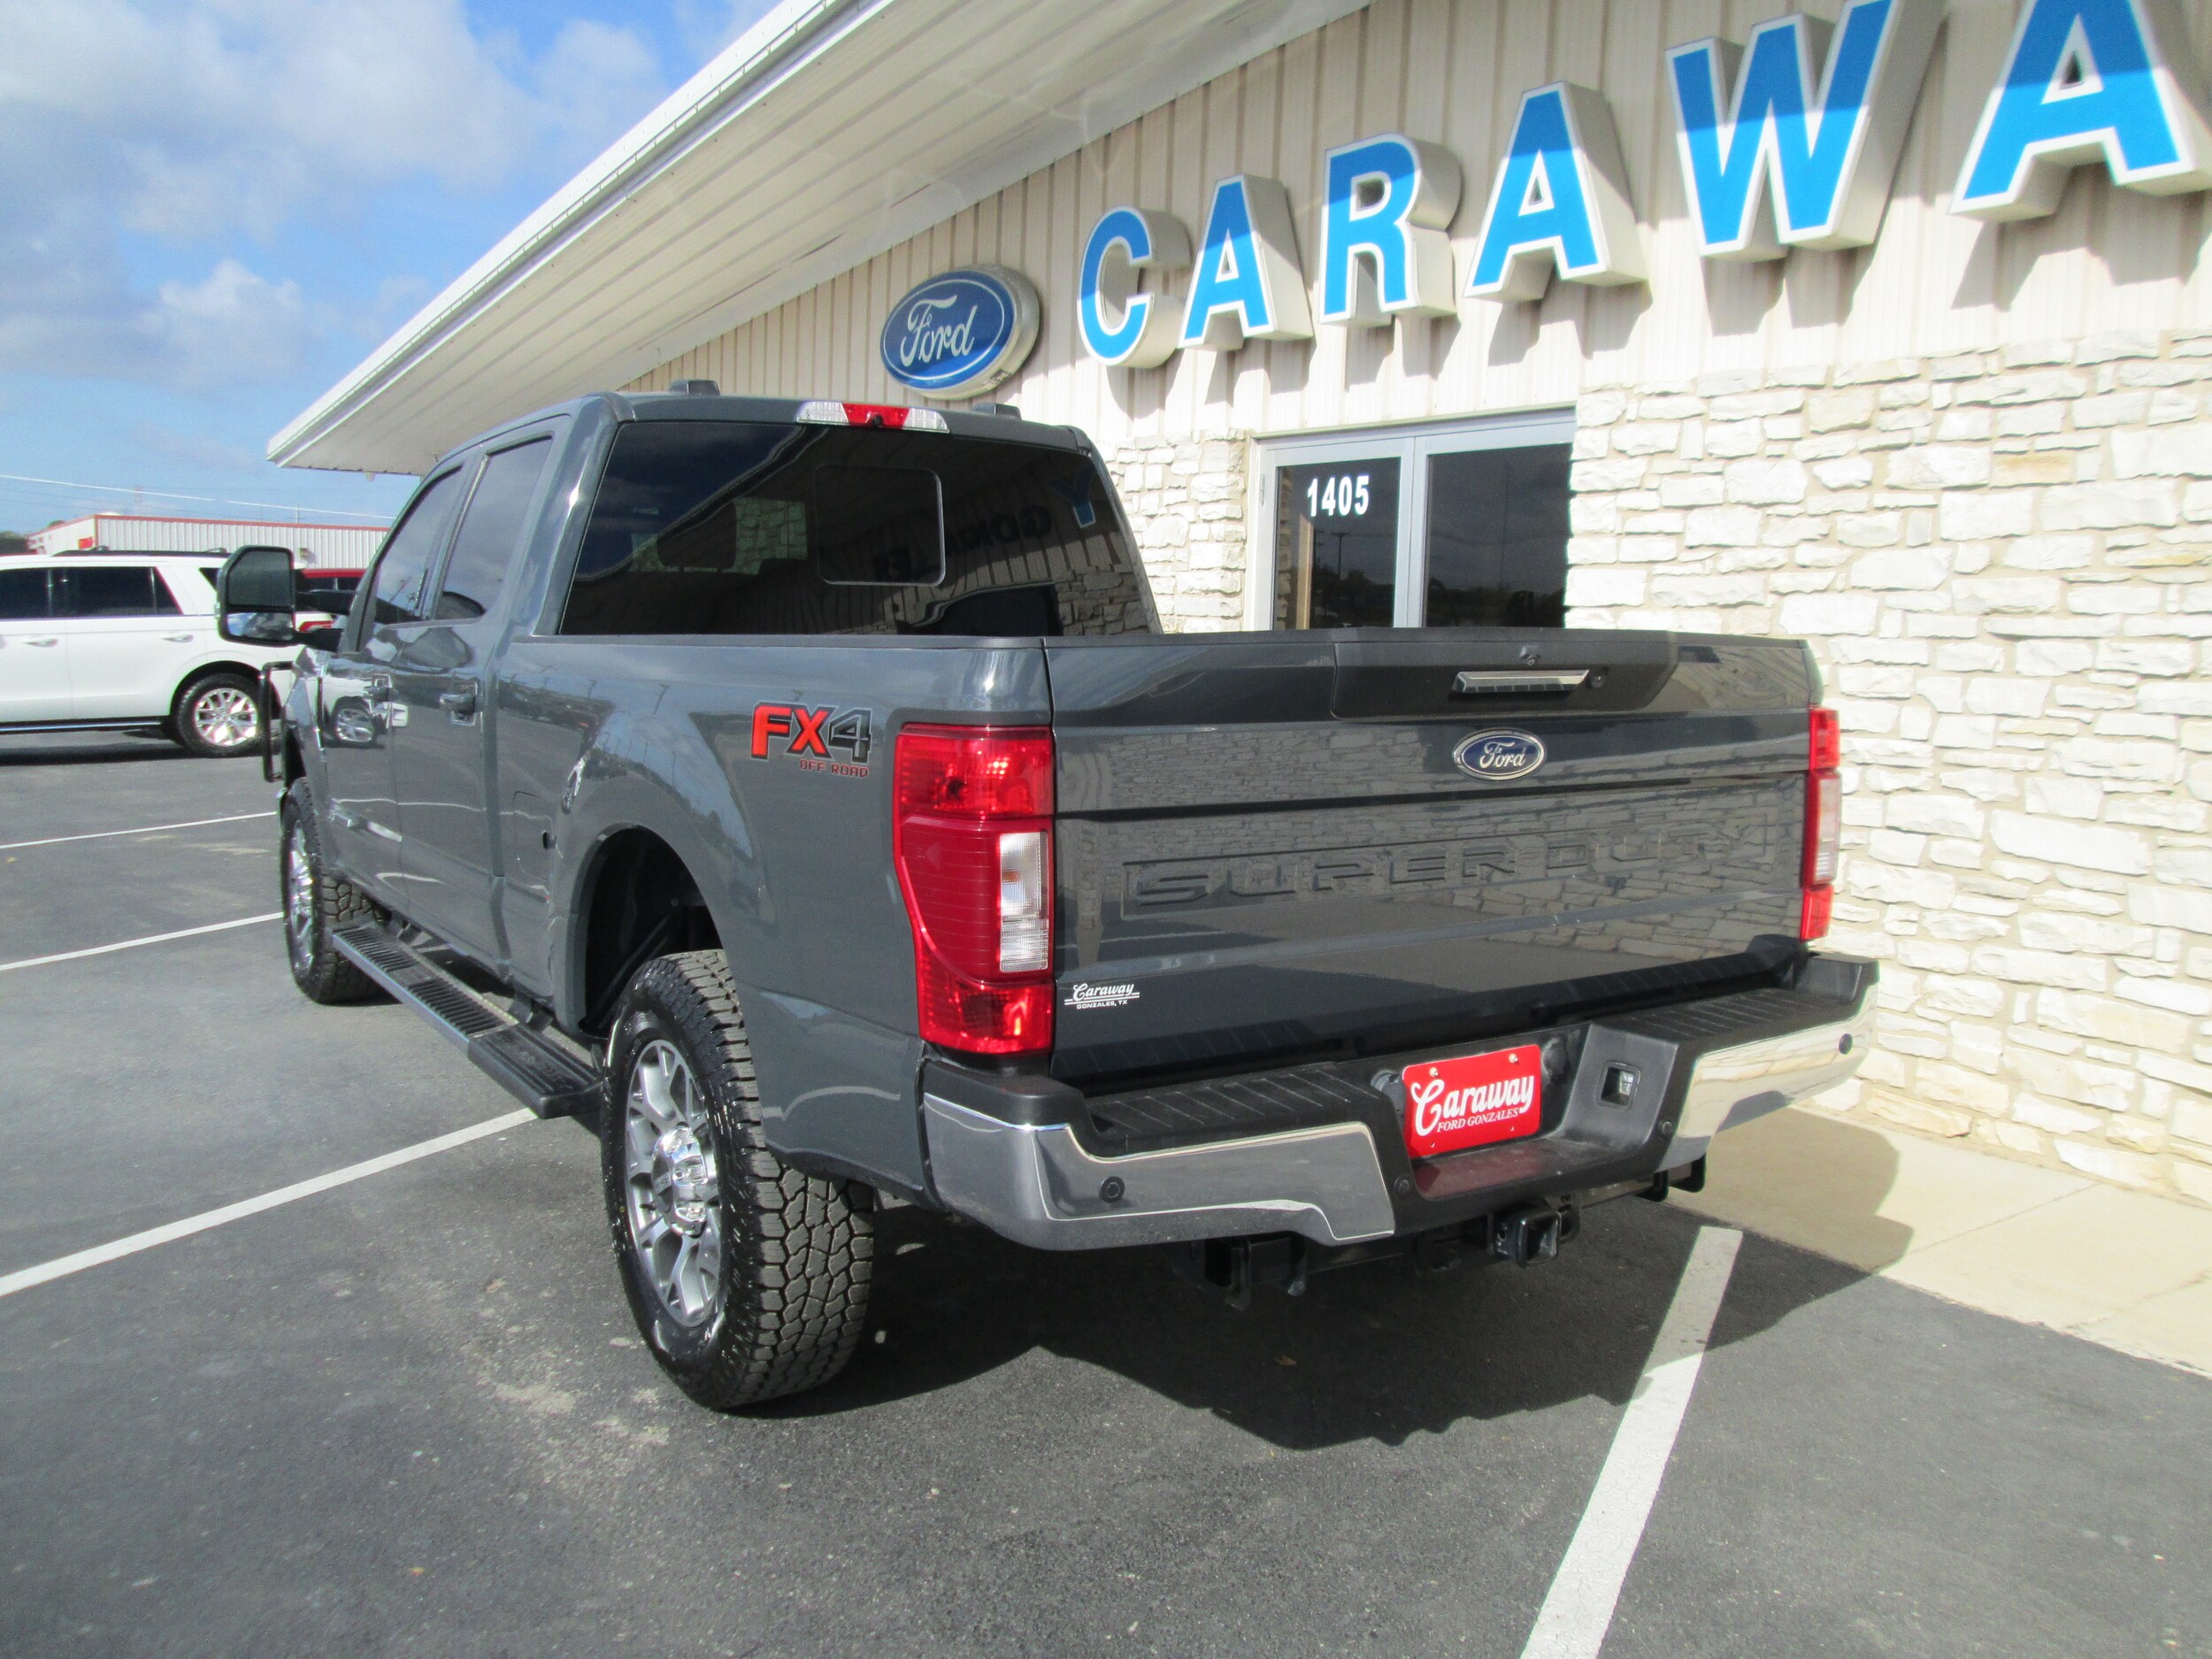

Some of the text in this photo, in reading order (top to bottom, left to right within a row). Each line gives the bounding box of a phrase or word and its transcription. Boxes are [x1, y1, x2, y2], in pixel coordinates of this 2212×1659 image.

[900, 294, 978, 367] Ford
[1307, 474, 1370, 517] 1405
[750, 700, 872, 764] FX4
[800, 759, 869, 777] OFF ROAD
[1479, 741, 1527, 769] Ford
[1135, 845, 1517, 906] SUPER
[1072, 983, 1134, 1002] Caraway
[1076, 1001, 1117, 1010] GONZALES,
[1410, 1075, 1534, 1137] Caraway
[1436, 1108, 1519, 1133] FORD GONZALES
